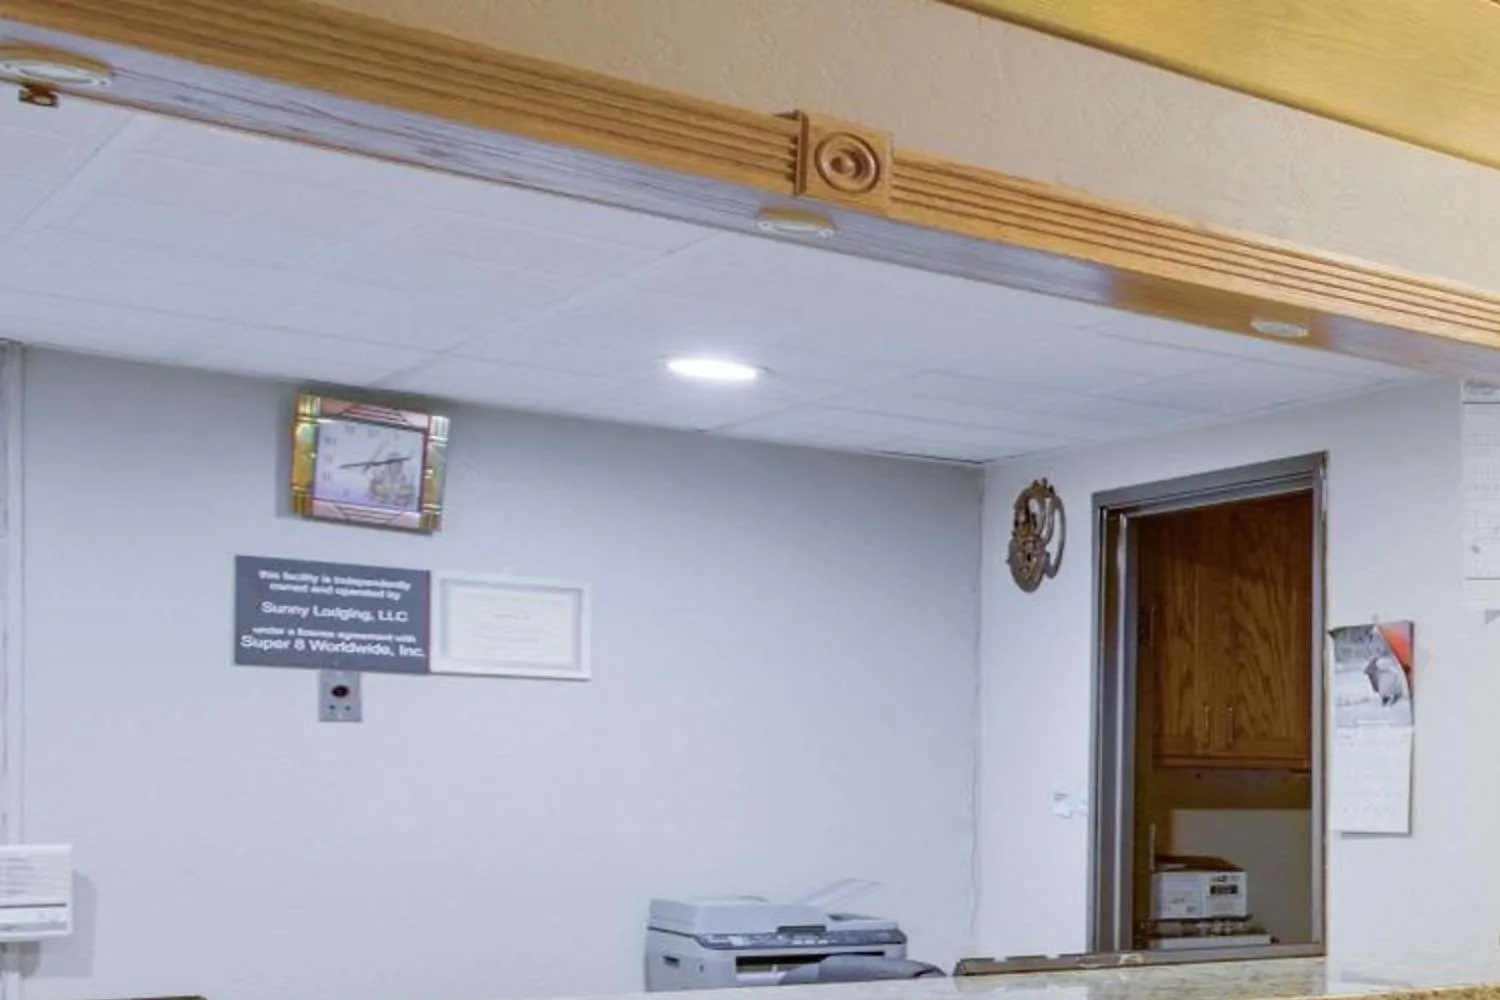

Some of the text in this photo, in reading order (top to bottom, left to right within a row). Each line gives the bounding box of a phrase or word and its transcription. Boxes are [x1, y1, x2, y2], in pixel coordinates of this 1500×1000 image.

[260, 601, 409, 622] Sunny Lodging, LLC
[240, 634, 426, 657] Super 8 Worldwide, Inc.
